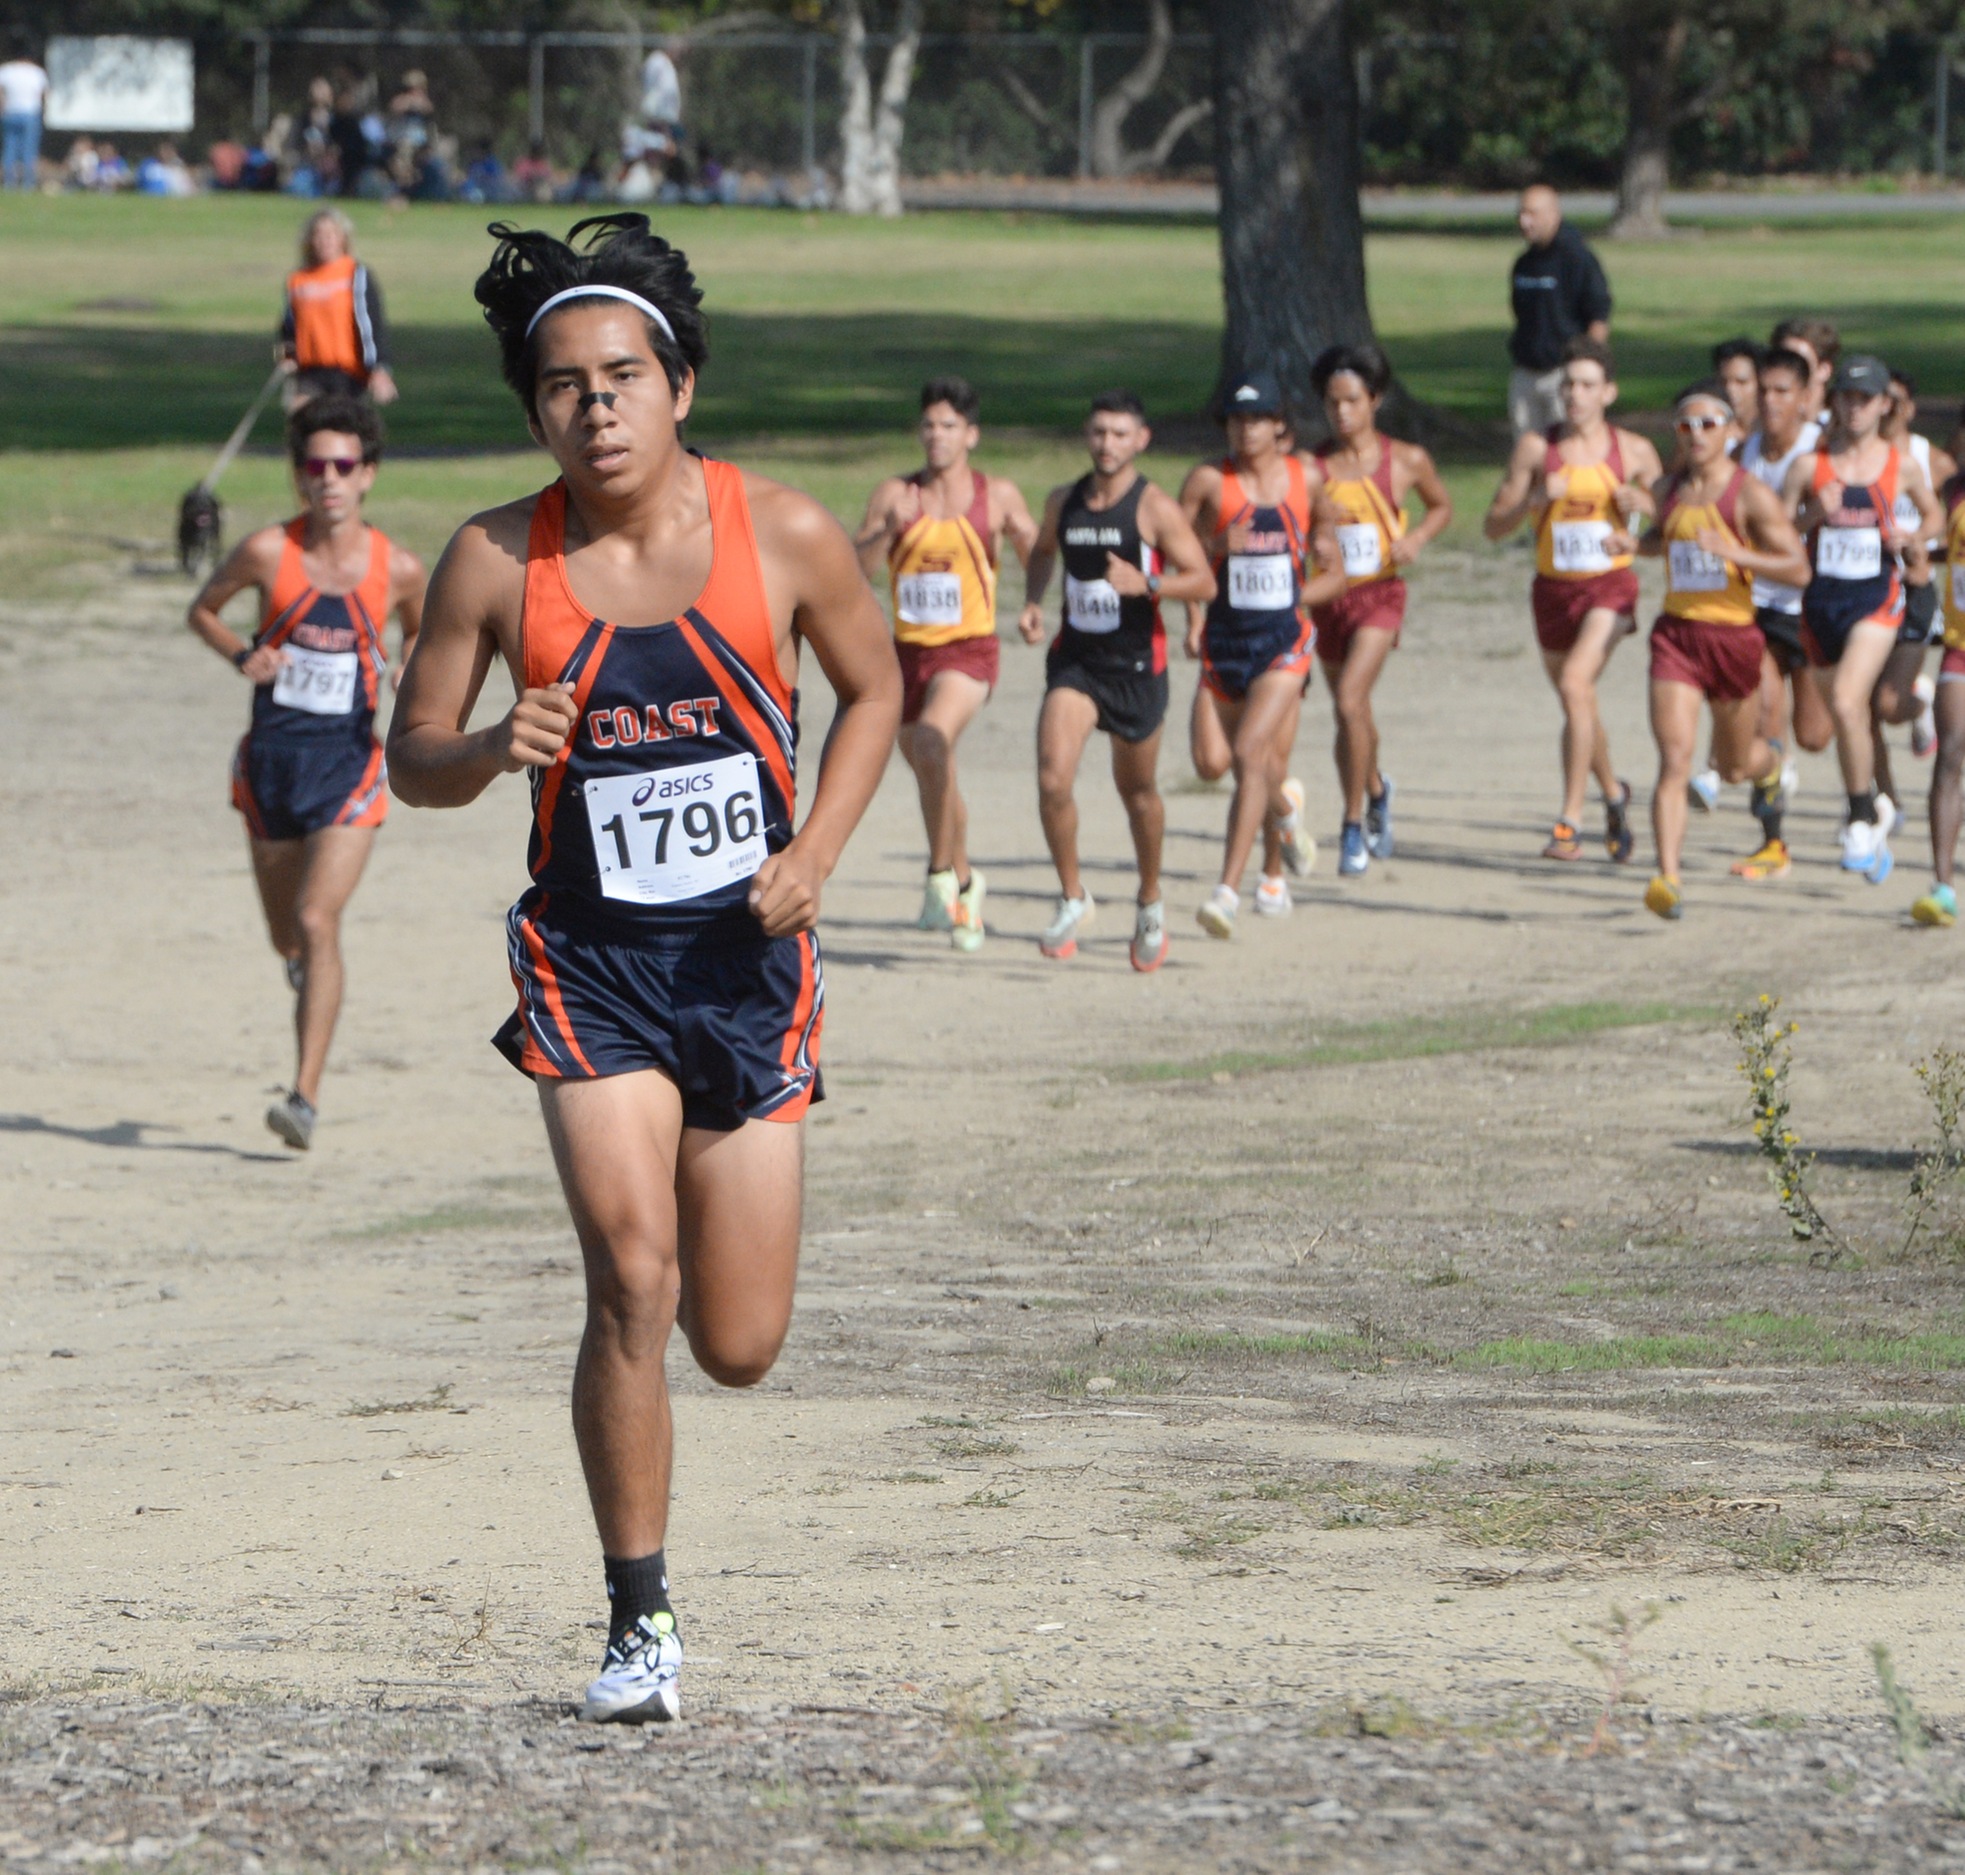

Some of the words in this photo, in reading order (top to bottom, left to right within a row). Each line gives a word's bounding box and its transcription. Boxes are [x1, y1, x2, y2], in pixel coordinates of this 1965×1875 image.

[278, 664, 351, 696] 1797
[587, 696, 721, 750] COAST
[658, 772, 714, 799] asics
[601, 790, 759, 870] 1796
